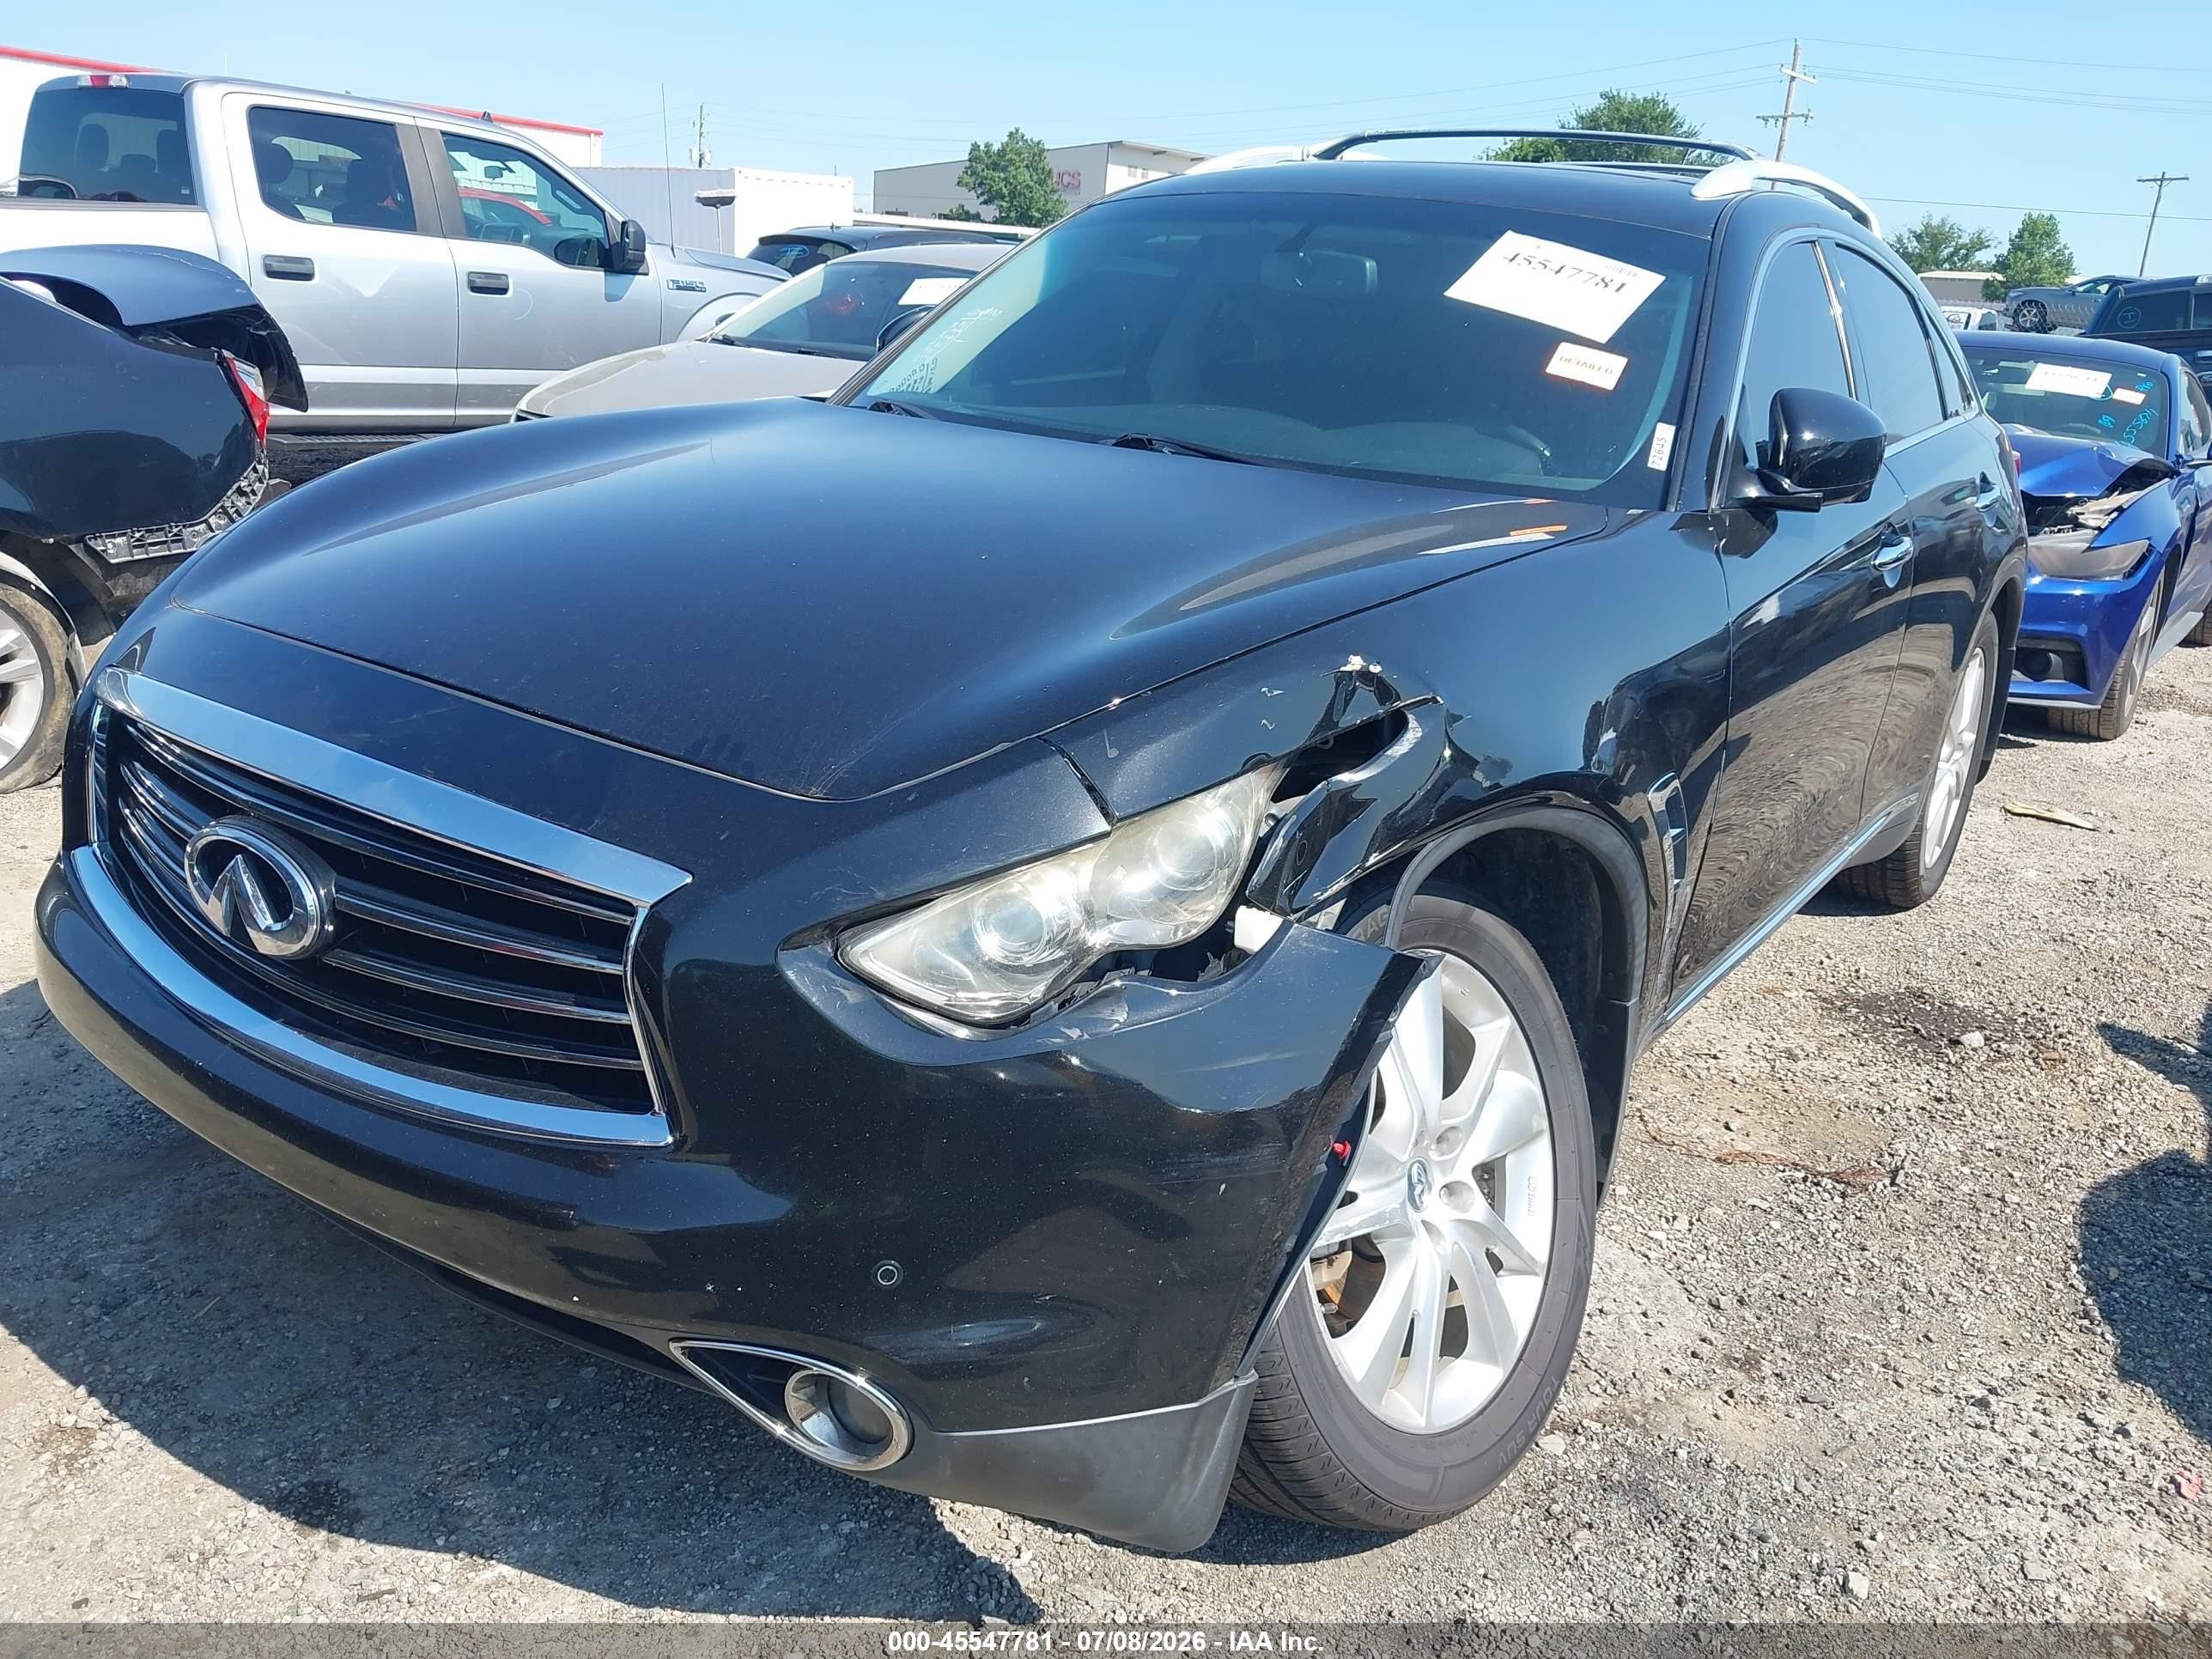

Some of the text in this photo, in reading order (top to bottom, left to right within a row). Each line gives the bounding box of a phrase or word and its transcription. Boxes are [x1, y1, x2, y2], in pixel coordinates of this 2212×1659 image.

[1504, 252, 1626, 293] 45547781
[1559, 356, 1614, 375] DETAILED
[1498, 1376, 1559, 1471] TOUR SUV
